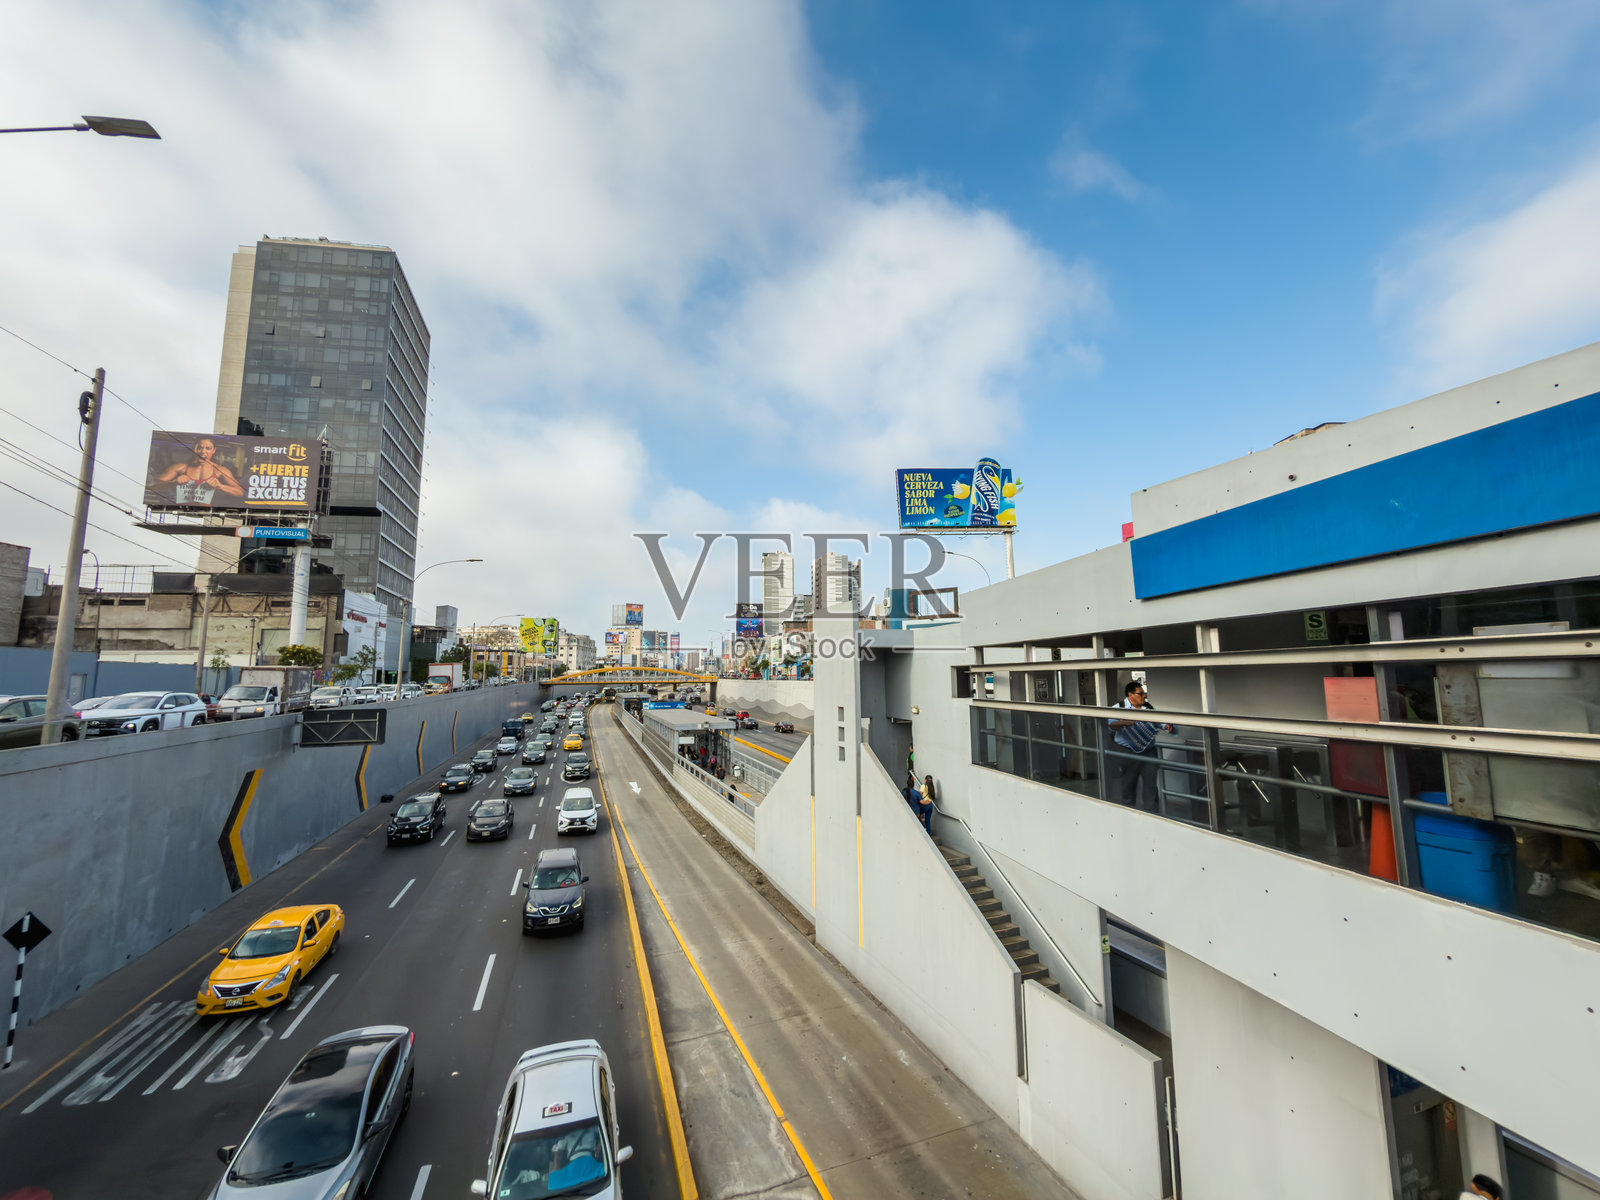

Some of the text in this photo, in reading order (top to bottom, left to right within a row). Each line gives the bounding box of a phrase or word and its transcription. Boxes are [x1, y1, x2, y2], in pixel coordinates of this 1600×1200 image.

[254, 443, 308, 459] smart fit
[250, 463, 310, 477] +FUERTE
[249, 474, 307, 490] QUE TUS
[903, 473, 932, 482] NUEVA
[975, 470, 992, 492] FLYING
[904, 481, 944, 490] CERVEZA
[247, 487, 306, 501] EXCUSAS
[905, 489, 935, 498] SABOR
[905, 498, 928, 506] LIMA
[983, 491, 999, 510] FISH
[906, 504, 935, 515] LIMÓN
[255, 529, 305, 538] PUNTOVISUAL
[1309, 614, 1323, 628] S
[1053, 650, 1061, 660] S
[549, 1105, 564, 1113] TAXI
